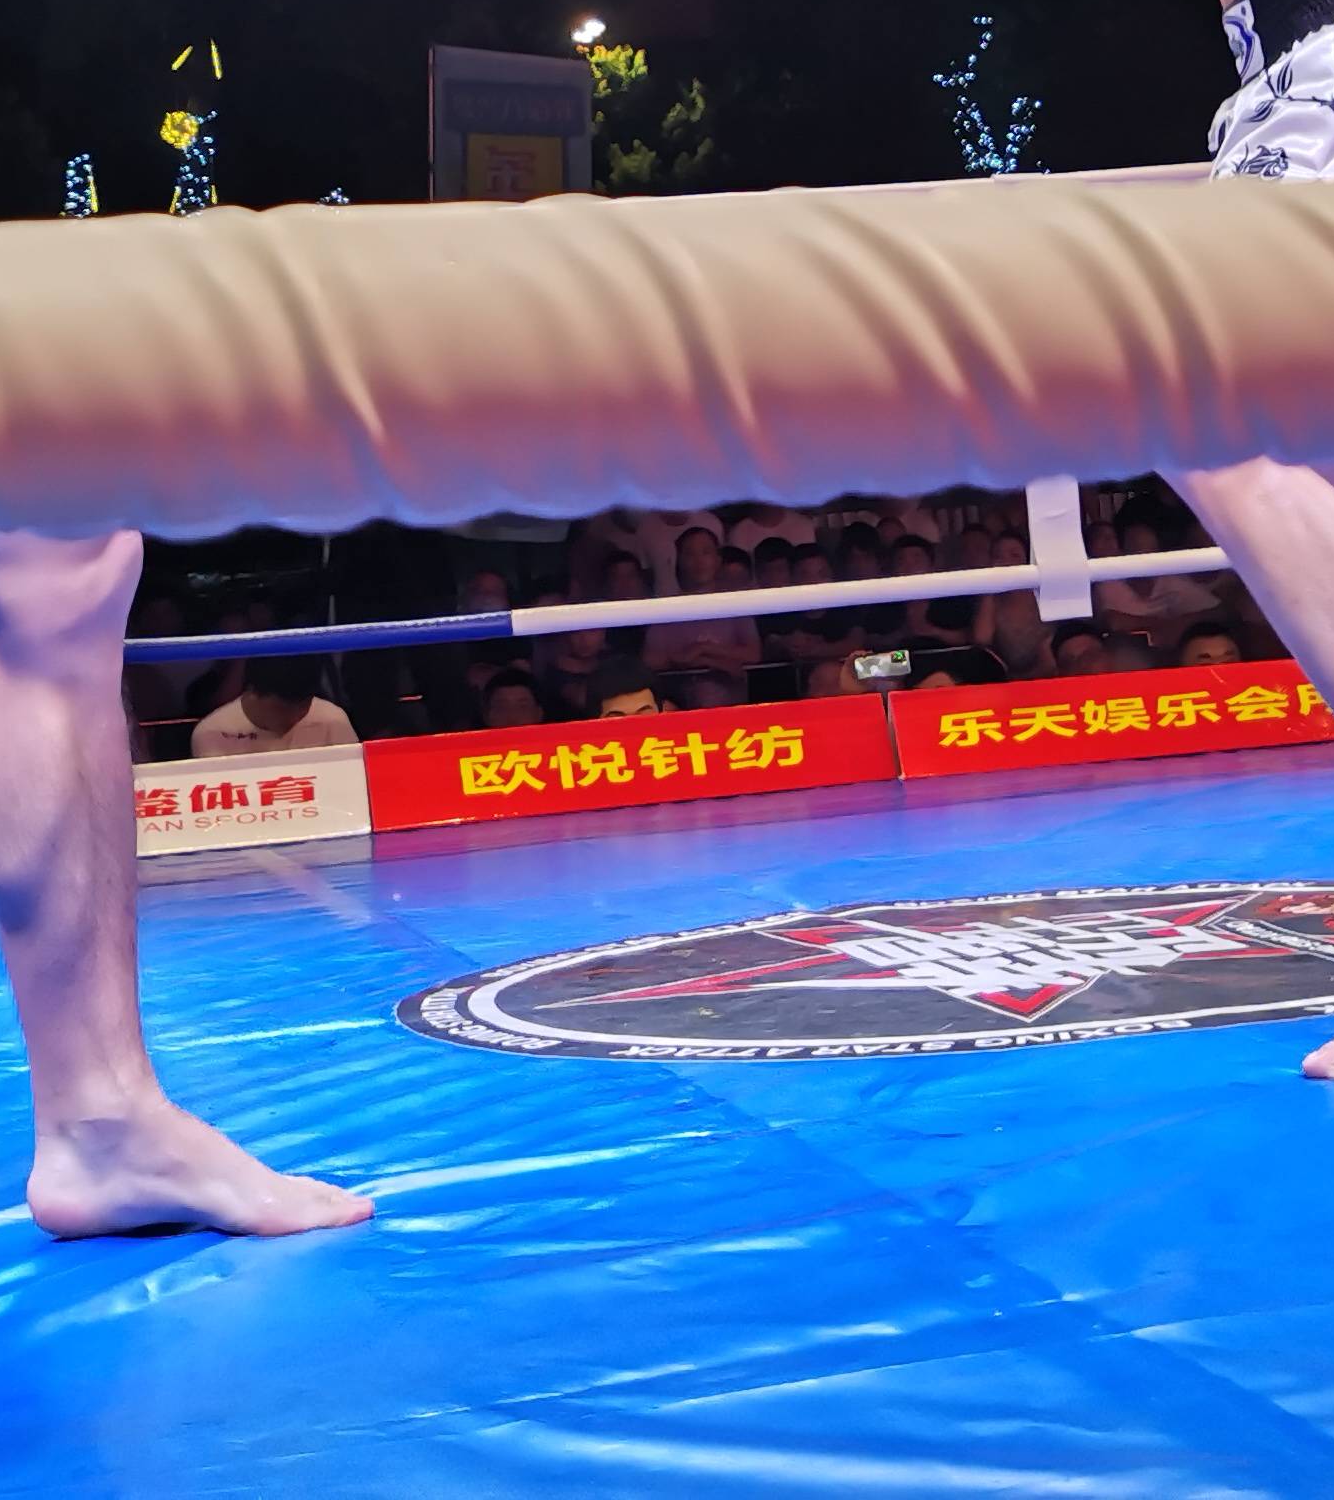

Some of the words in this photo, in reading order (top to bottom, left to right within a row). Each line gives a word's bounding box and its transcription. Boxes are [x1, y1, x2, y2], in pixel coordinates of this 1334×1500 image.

[460, 726, 806, 797] 欧悦针纺
[194, 806, 320, 830] SPORTS
[973, 1019, 1193, 1048] BOXING
[607, 1045, 806, 1057] ATTACK
[811, 1040, 956, 1056] STAR
